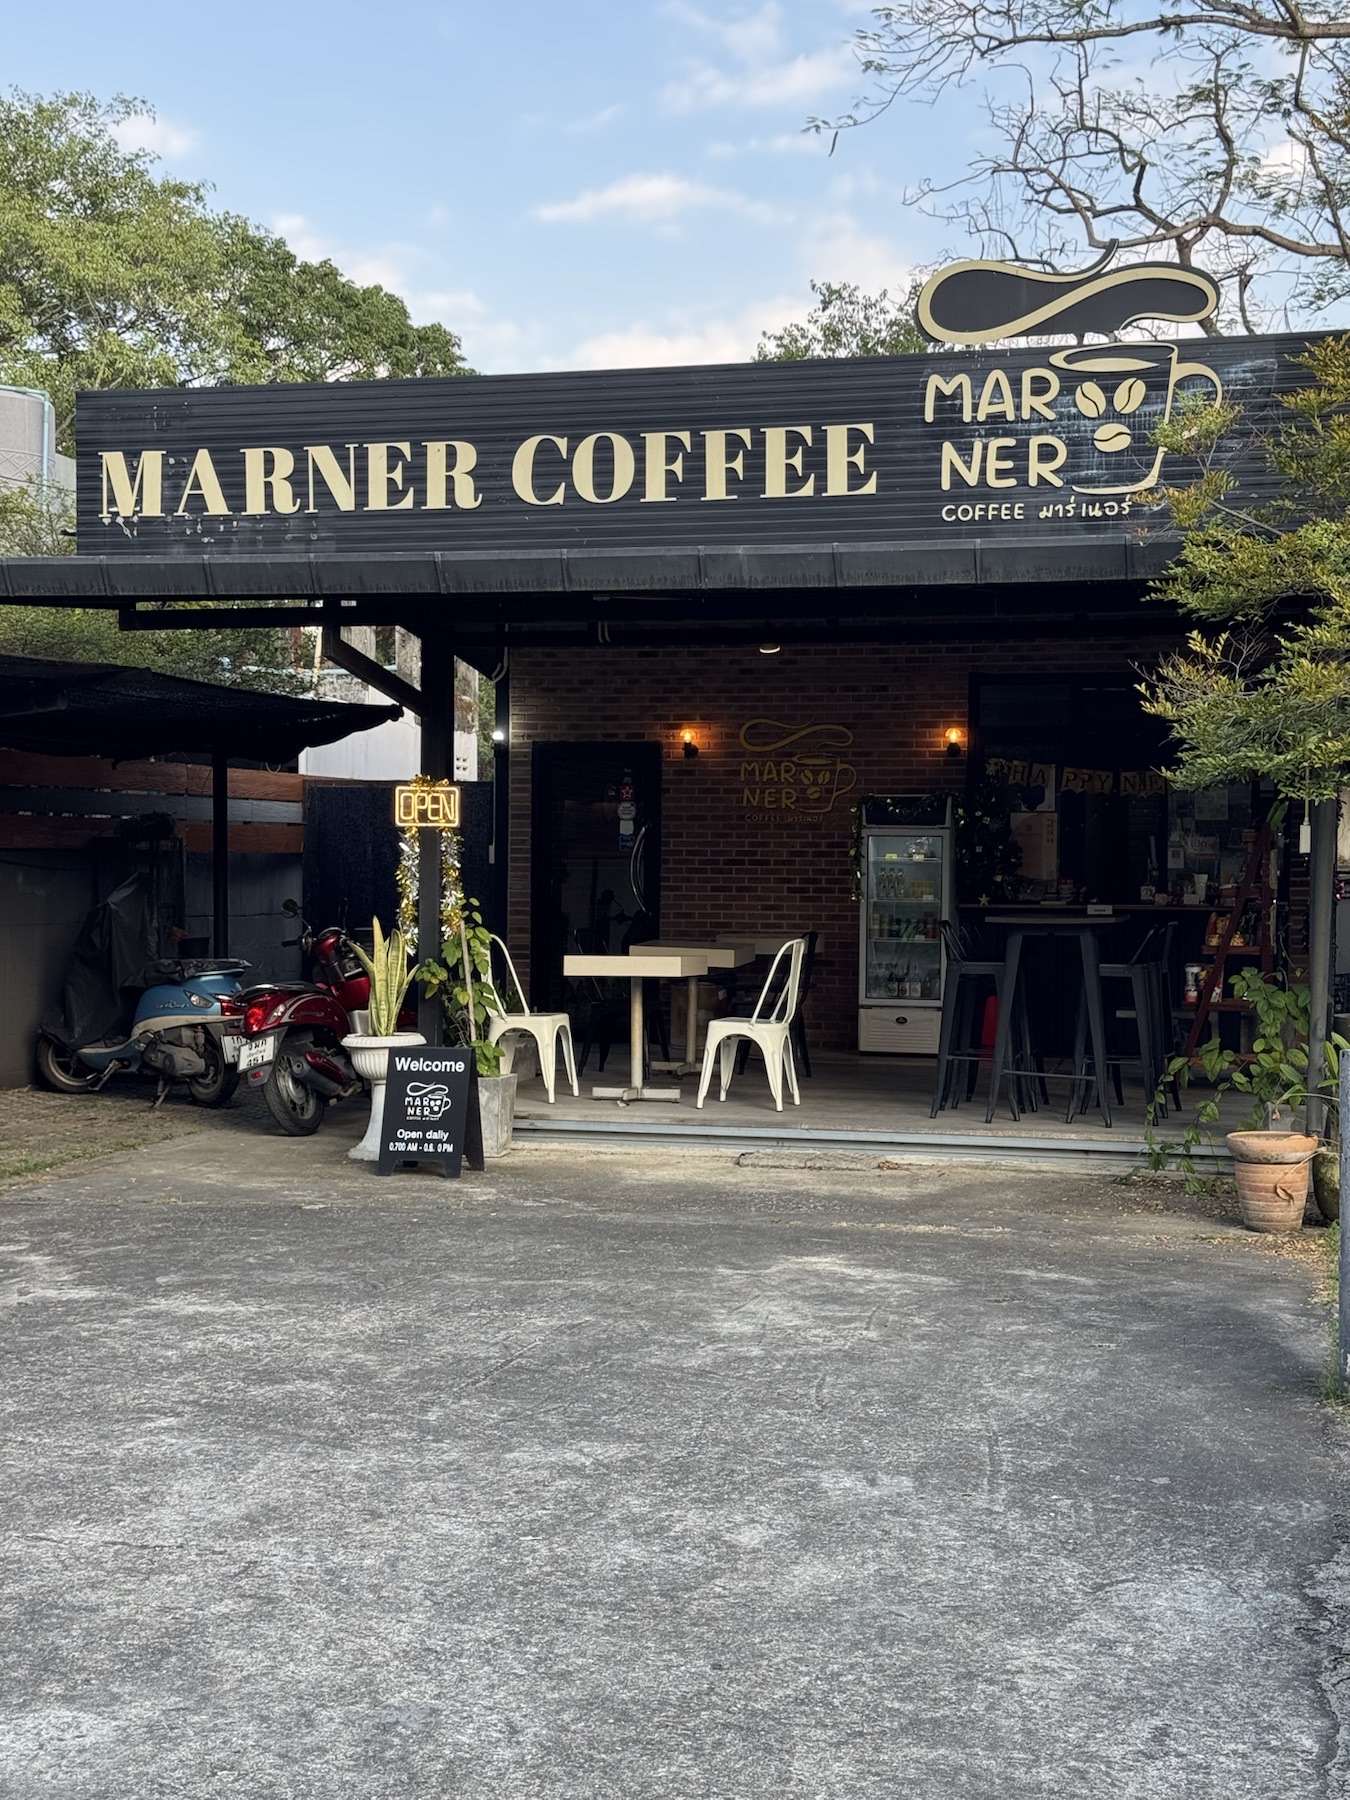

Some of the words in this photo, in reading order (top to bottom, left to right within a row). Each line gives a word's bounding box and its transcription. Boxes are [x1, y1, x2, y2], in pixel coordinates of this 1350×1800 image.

[924, 367, 1060, 423] MAR
[97, 440, 483, 517] MARNER
[511, 422, 878, 505] COFFEE
[941, 435, 1067, 491] NER
[941, 503, 1025, 522] COFFEE
[740, 760, 797, 783] MAR
[1012, 764, 1111, 792] HAPPY
[1122, 774, 1163, 793] NE
[400, 792, 454, 820] OPEN
[742, 787, 797, 810] NER
[395, 1057, 465, 1073] Welcome
[404, 1096, 430, 1106] MAR
[407, 1106, 430, 1116] NER
[397, 1128, 423, 1140] Open
[425, 1129, 449, 1142] daily
[406, 1142, 418, 1152] AM
